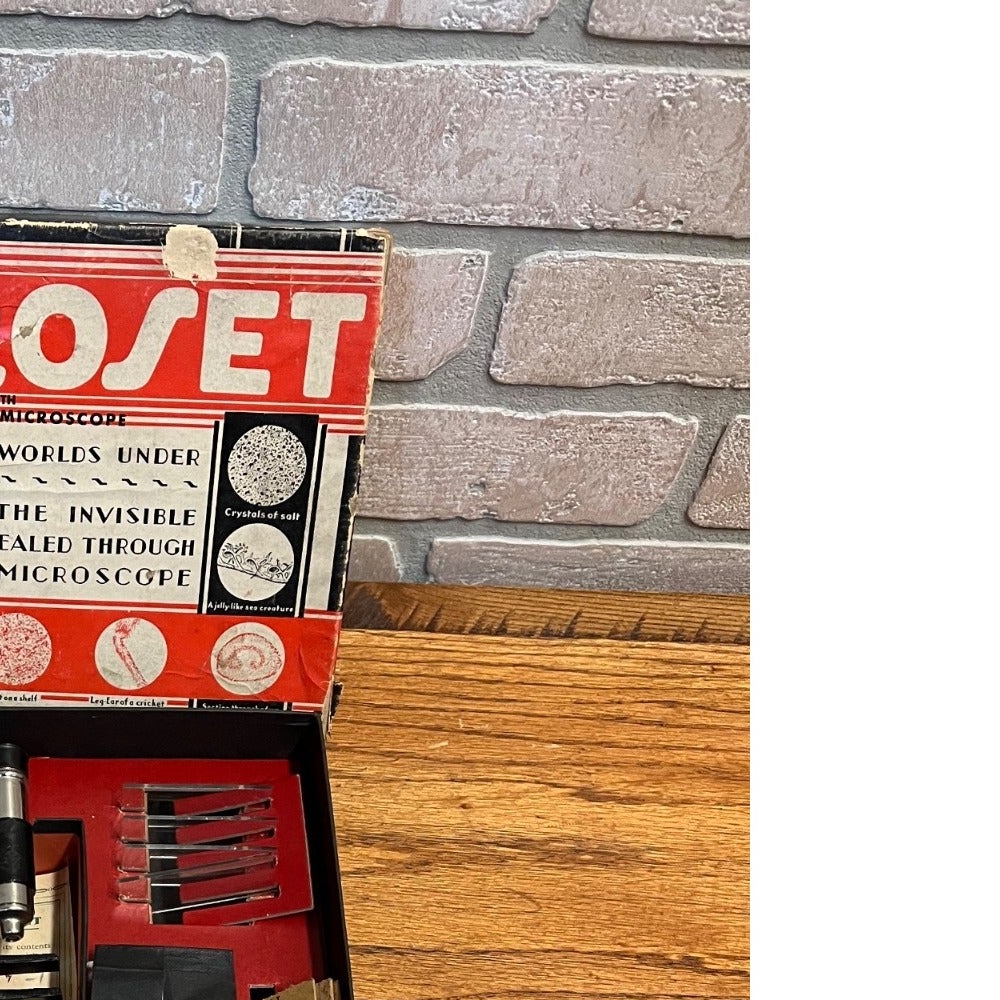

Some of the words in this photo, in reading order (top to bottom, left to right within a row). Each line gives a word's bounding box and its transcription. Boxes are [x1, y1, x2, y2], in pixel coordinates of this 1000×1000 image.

[0, 409, 127, 427] MICROSCOPE
[118, 447, 200, 467] UNDER
[69, 505, 197, 527] INVISIBLE
[224, 507, 266, 519] Crystals
[267, 510, 279, 520] of
[280, 512, 301, 521] salt
[82, 536, 196, 557] THROUGH
[259, 604, 294, 613] creature
[19, 693, 38, 702] shelf
[135, 698, 165, 707] cricket
